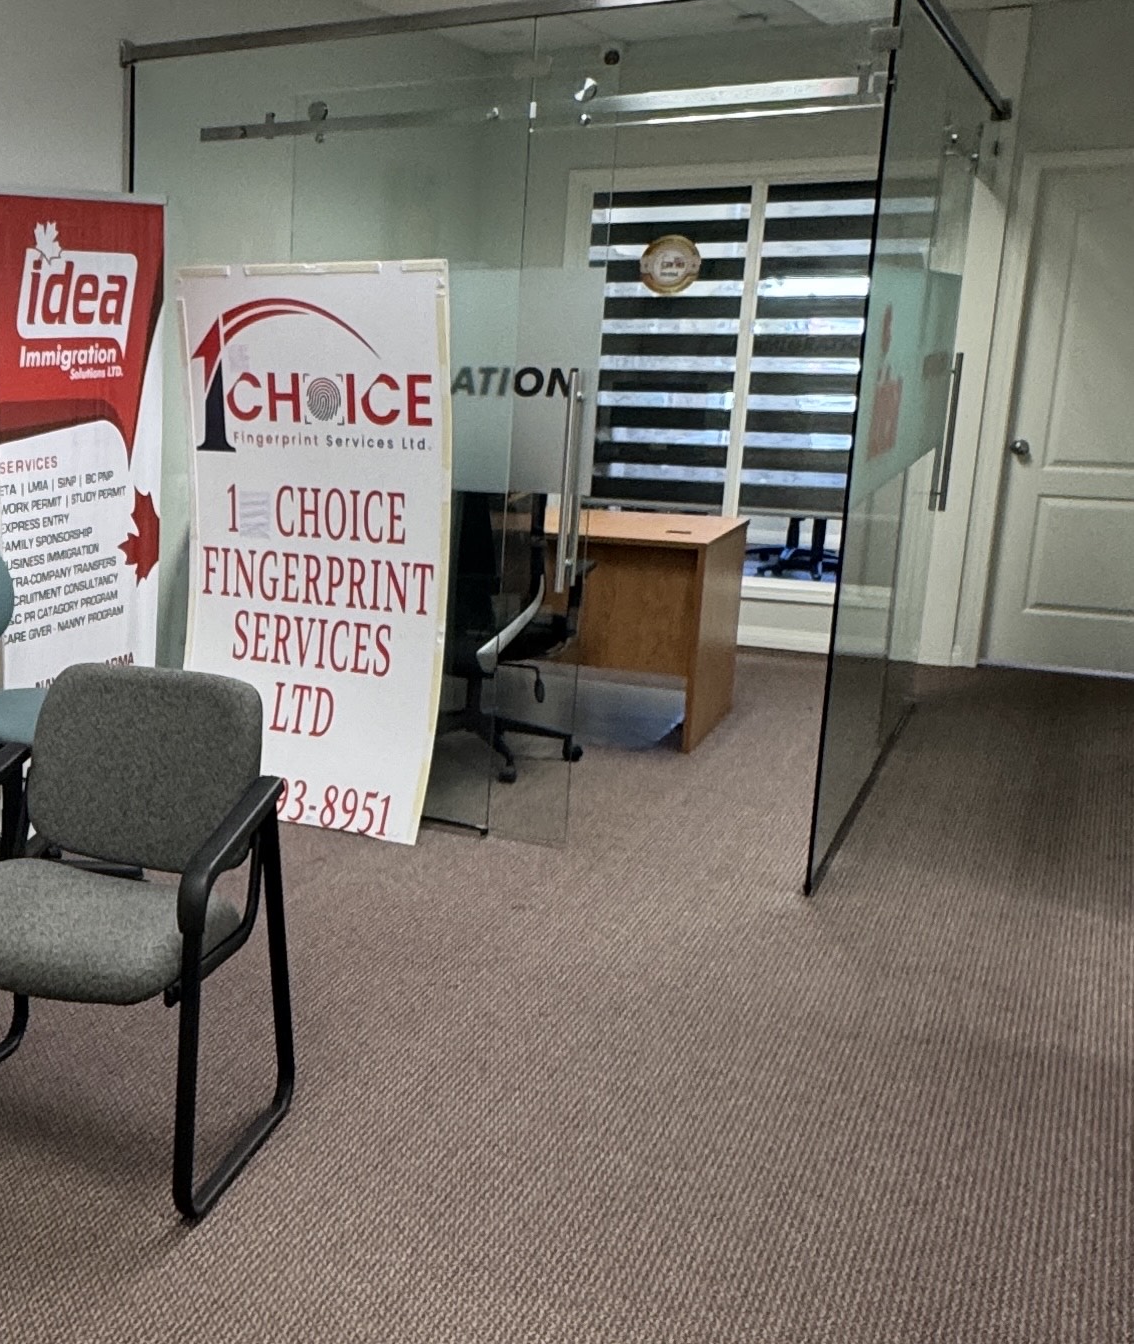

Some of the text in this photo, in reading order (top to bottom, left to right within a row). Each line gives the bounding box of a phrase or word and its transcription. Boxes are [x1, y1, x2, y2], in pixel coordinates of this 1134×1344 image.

[27, 259, 128, 325] idea
[19, 343, 117, 371] Immigration
[69, 367, 106, 381] Solutions
[233, 431, 319, 448] Fingerprint
[326, 435, 394, 450] Services
[0, 456, 58, 475] SERVICES
[85, 473, 97, 485] BC
[31, 495, 63, 511] PERMIT
[71, 492, 96, 506] STUDY
[97, 485, 127, 500] PERMIT
[42, 513, 70, 528] ENTRY
[275, 485, 406, 545] CHOICE
[46, 542, 100, 563] IMMIGRATION
[63, 572, 119, 596] CONSULTANCY
[202, 545, 434, 616] FINGERPRINT
[24, 610, 36, 623] PR
[80, 589, 119, 608] PROGRAM
[28, 623, 52, 640] GIVER
[57, 615, 86, 632] NANNY
[87, 604, 125, 625] PROGRAM
[232, 609, 391, 678] SERVICES
[269, 681, 335, 738] LTD
